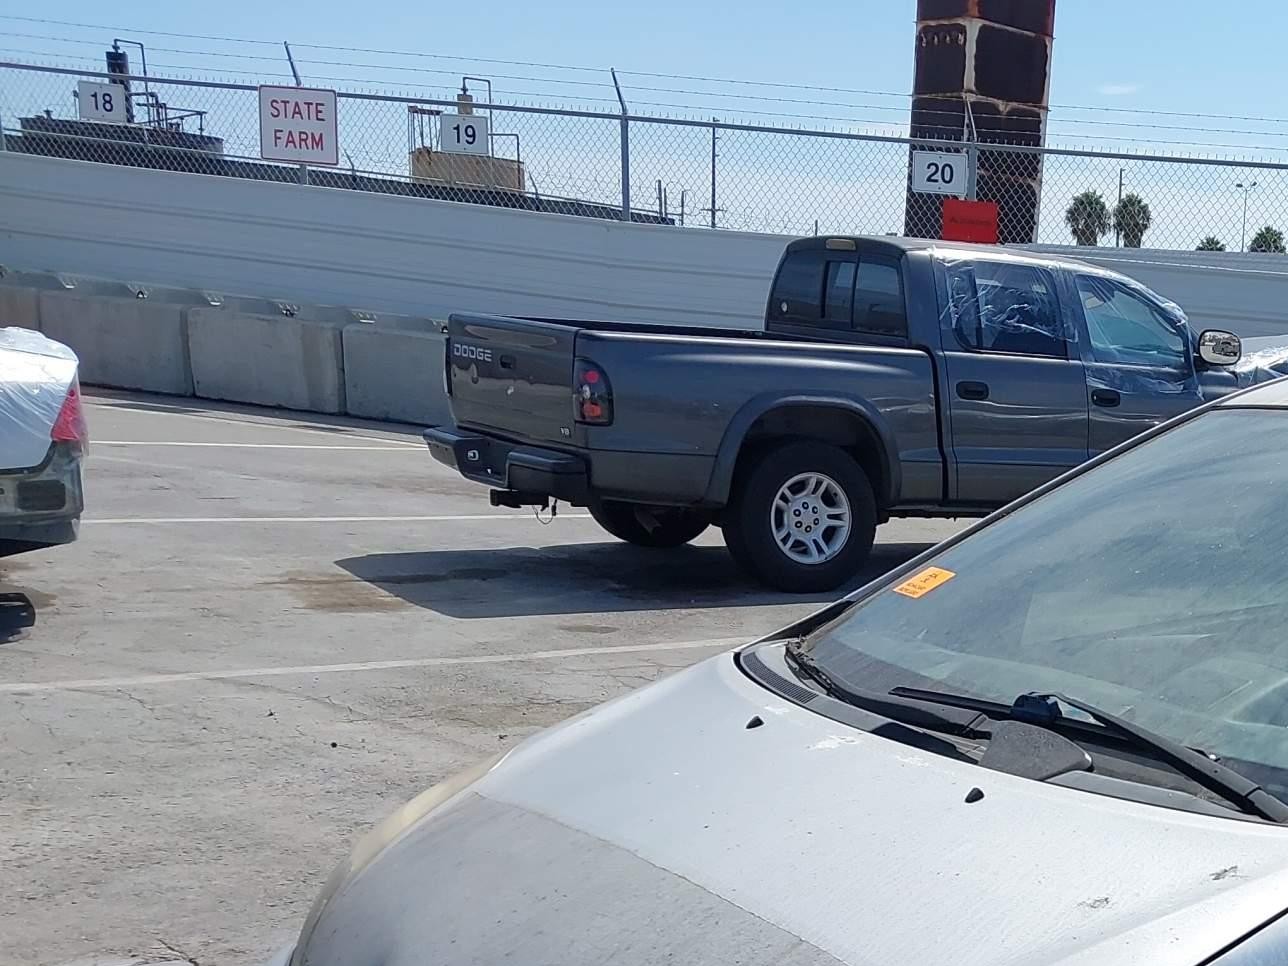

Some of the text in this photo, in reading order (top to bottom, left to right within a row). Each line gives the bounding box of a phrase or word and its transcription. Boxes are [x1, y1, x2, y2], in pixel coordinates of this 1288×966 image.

[90, 92, 113, 112] 18
[270, 99, 325, 121] STATE
[273, 129, 324, 151] FARM
[452, 123, 476, 145] 19
[925, 162, 954, 184] 20
[454, 343, 492, 362] DODGE
